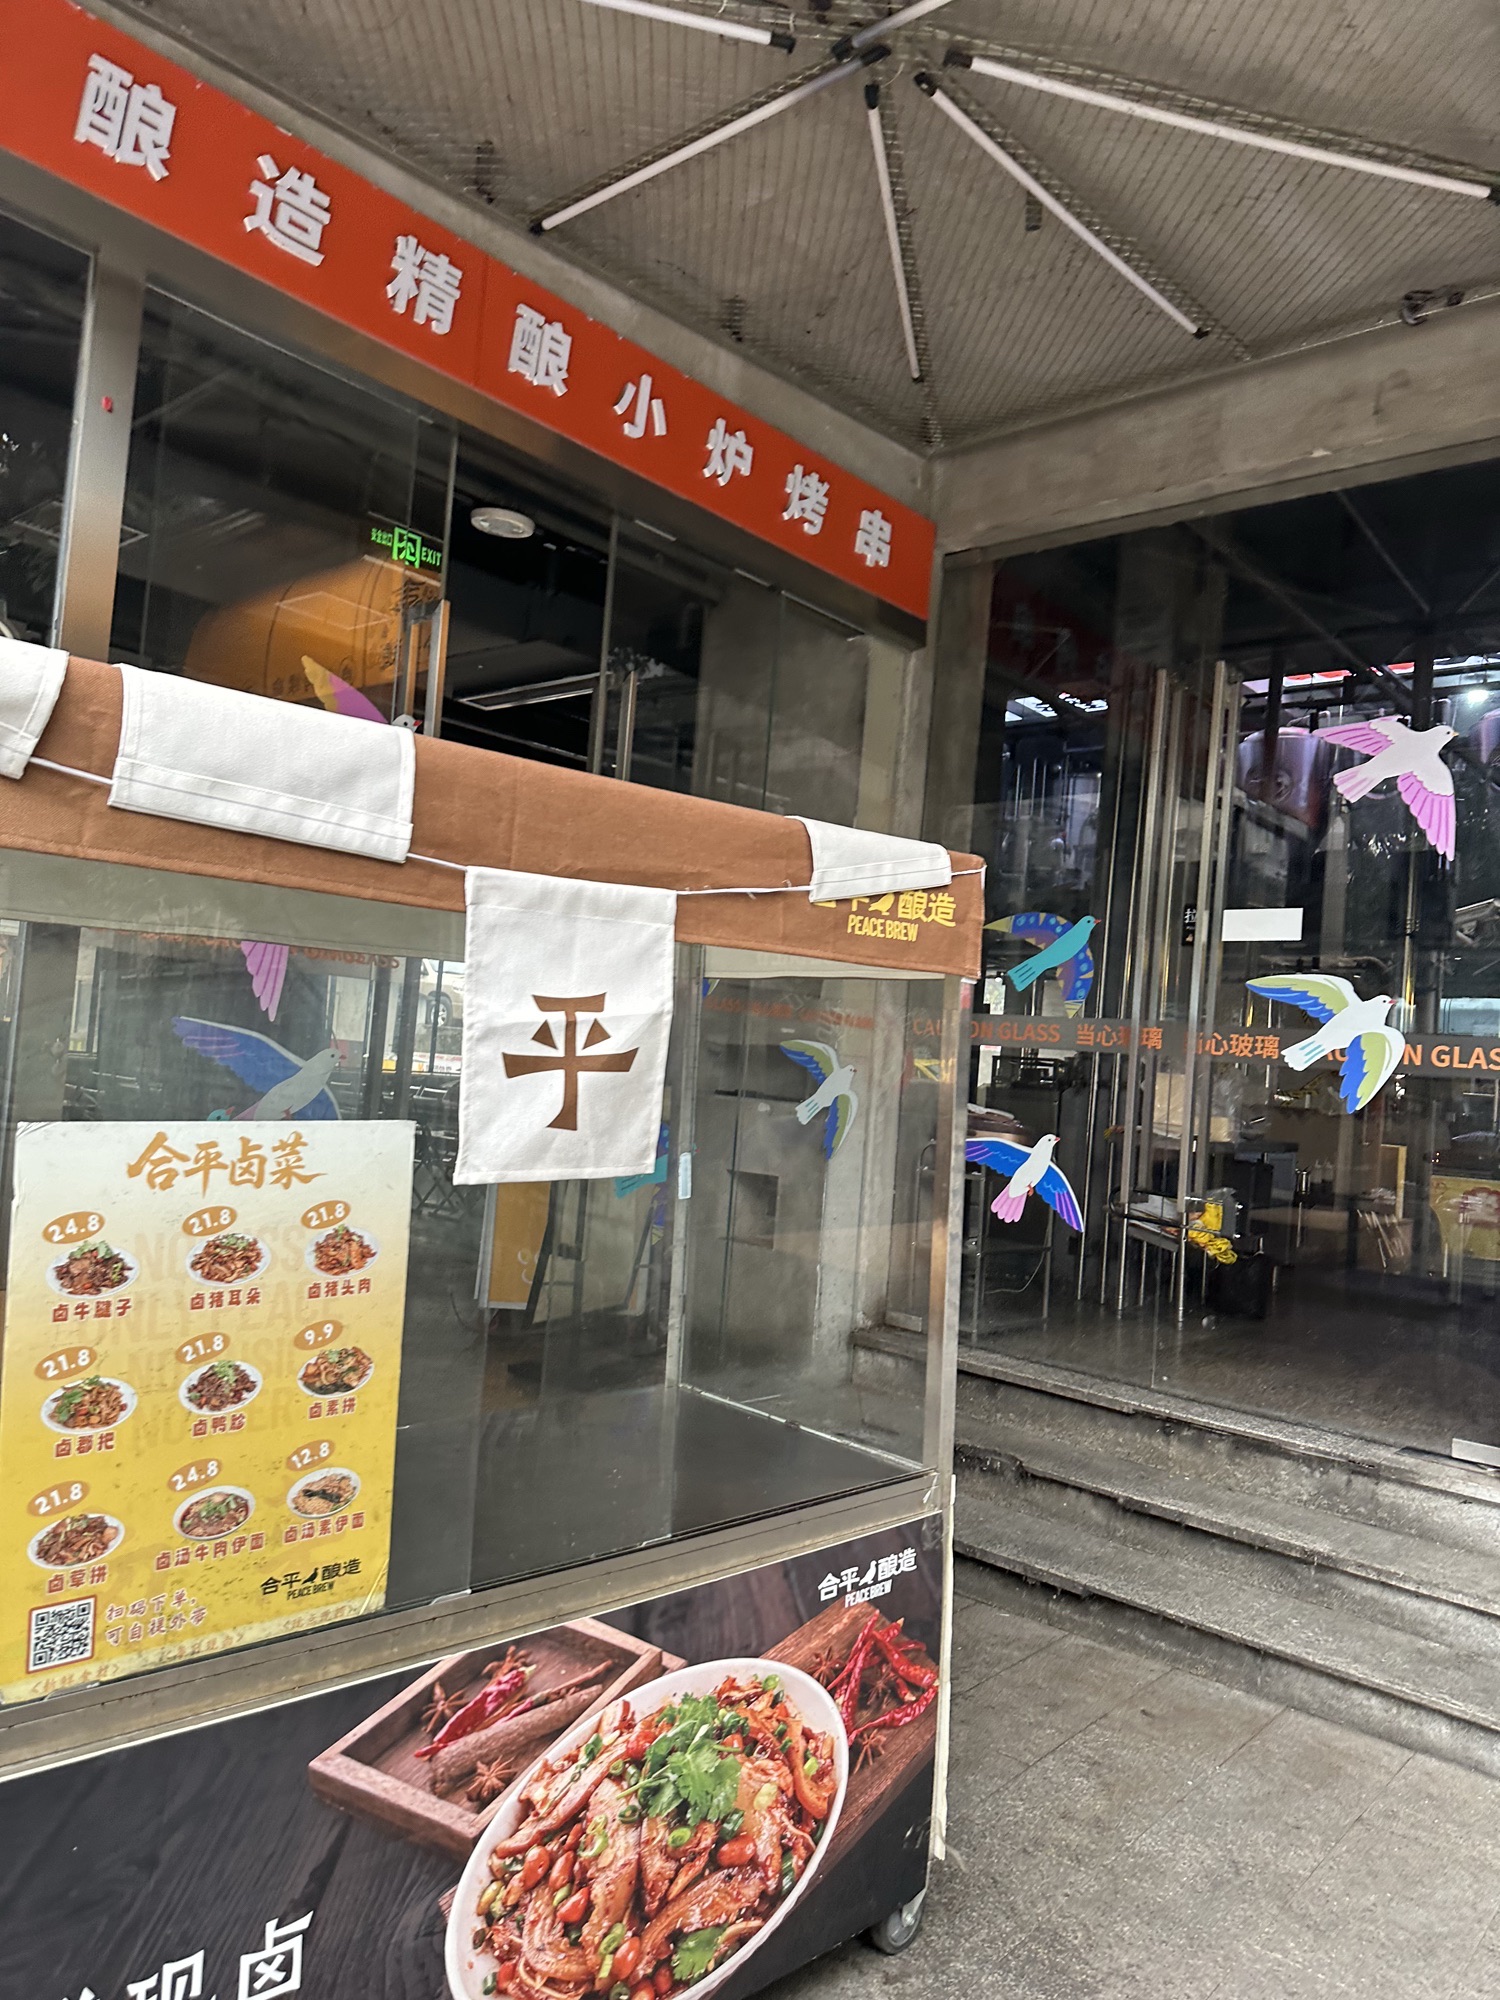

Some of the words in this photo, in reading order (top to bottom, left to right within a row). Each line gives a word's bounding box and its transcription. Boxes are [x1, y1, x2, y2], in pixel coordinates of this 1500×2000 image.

[75, 53, 892, 568] 酿造精酿小炉烤串
[421, 547, 442, 566] EXIT
[847, 915, 885, 938] PEACE
[886, 918, 919, 942] BREW
[998, 1023, 1060, 1043] GLASS
[502, 992, 639, 1131] 平
[128, 1131, 328, 1198] 合平卤菜
[48, 1214, 100, 1242] 24.8
[189, 1209, 231, 1235] 21.8
[307, 1203, 345, 1227] 21.8
[190, 1287, 261, 1310] 卤猪耳朵
[308, 1277, 371, 1299] 卤猪头肉
[304, 1323, 334, 1345] 9.9
[182, 1334, 224, 1362] 21.8
[42, 1348, 91, 1378] 21.8
[309, 1397, 356, 1419] 卤素拼
[292, 1441, 330, 1469] 12.8
[172, 1460, 219, 1491] 24.8
[35, 1483, 83, 1514] 21.8
[287, 1584, 311, 1600] PEACE
[312, 1580, 335, 1595] BREW
[845, 1587, 870, 1608] PEACE
[870, 1579, 893, 1600] BREW
